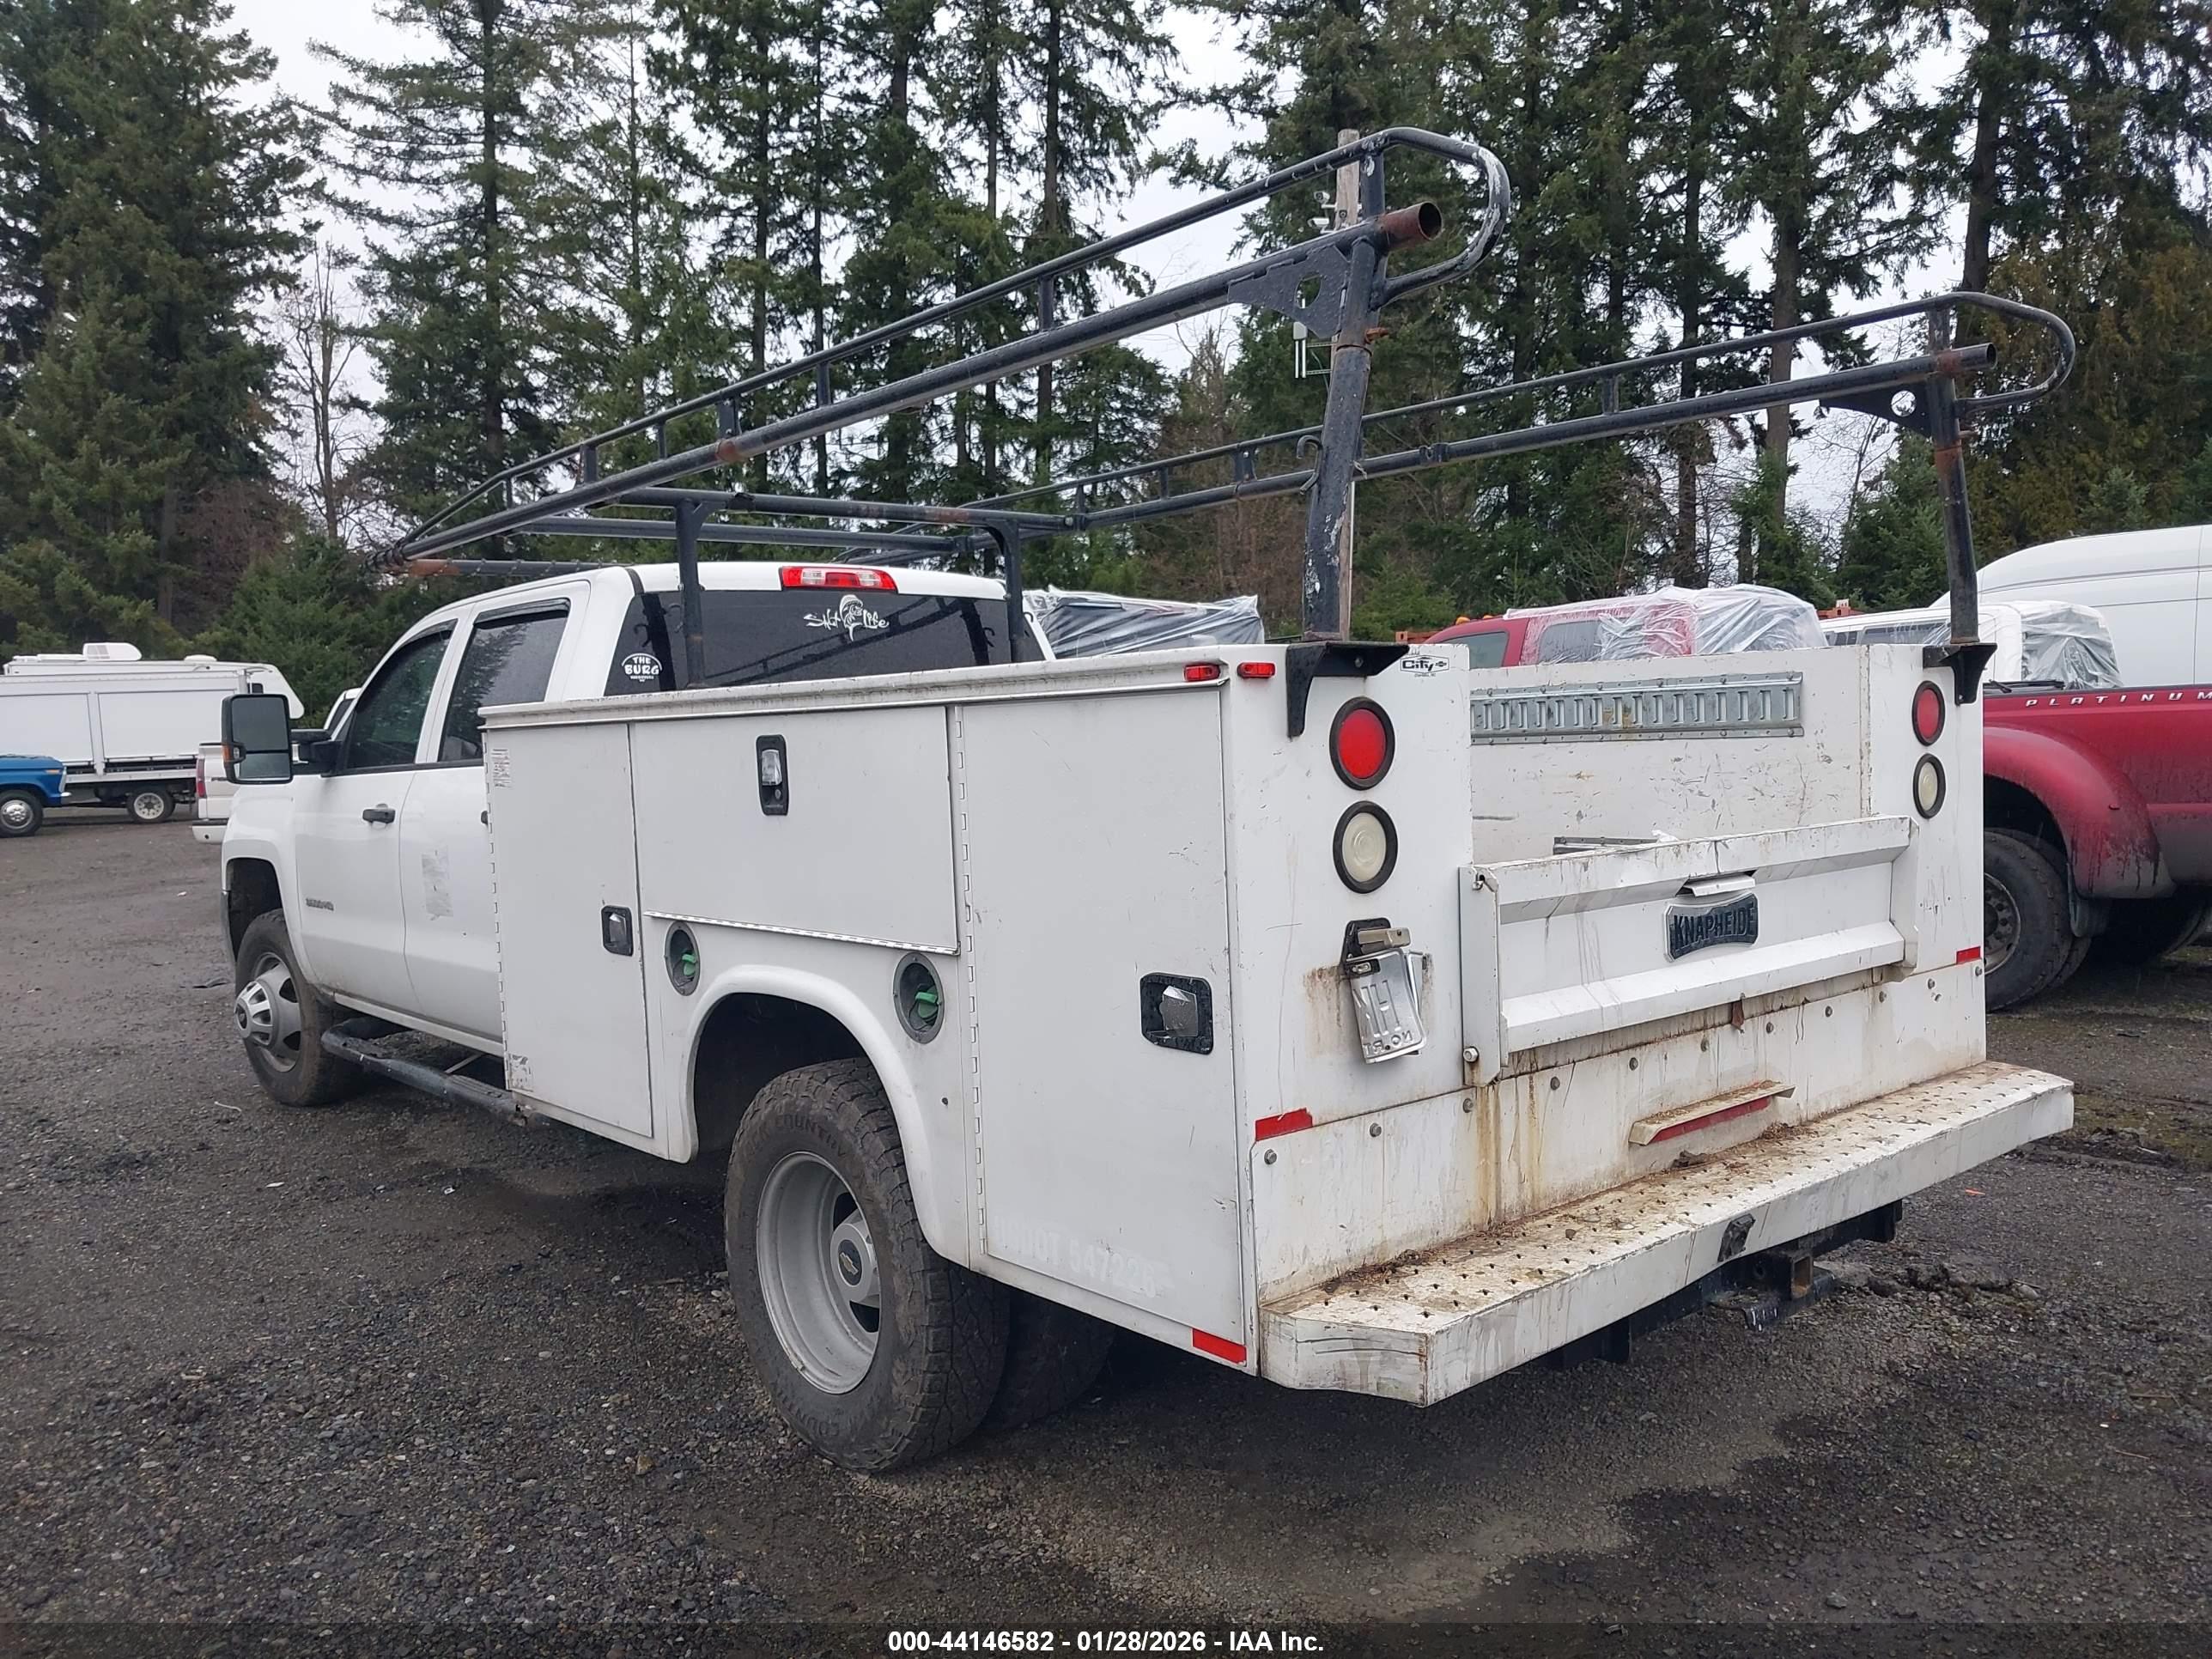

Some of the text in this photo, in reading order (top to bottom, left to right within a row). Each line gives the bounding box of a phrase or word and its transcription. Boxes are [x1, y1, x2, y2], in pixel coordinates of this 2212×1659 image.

[632, 656, 652, 665] THE
[1401, 659, 1435, 672] City
[624, 664, 659, 675] BURG
[2025, 690, 2212, 708] PLATINUM
[1672, 902, 1756, 950] KNAPHEIDE
